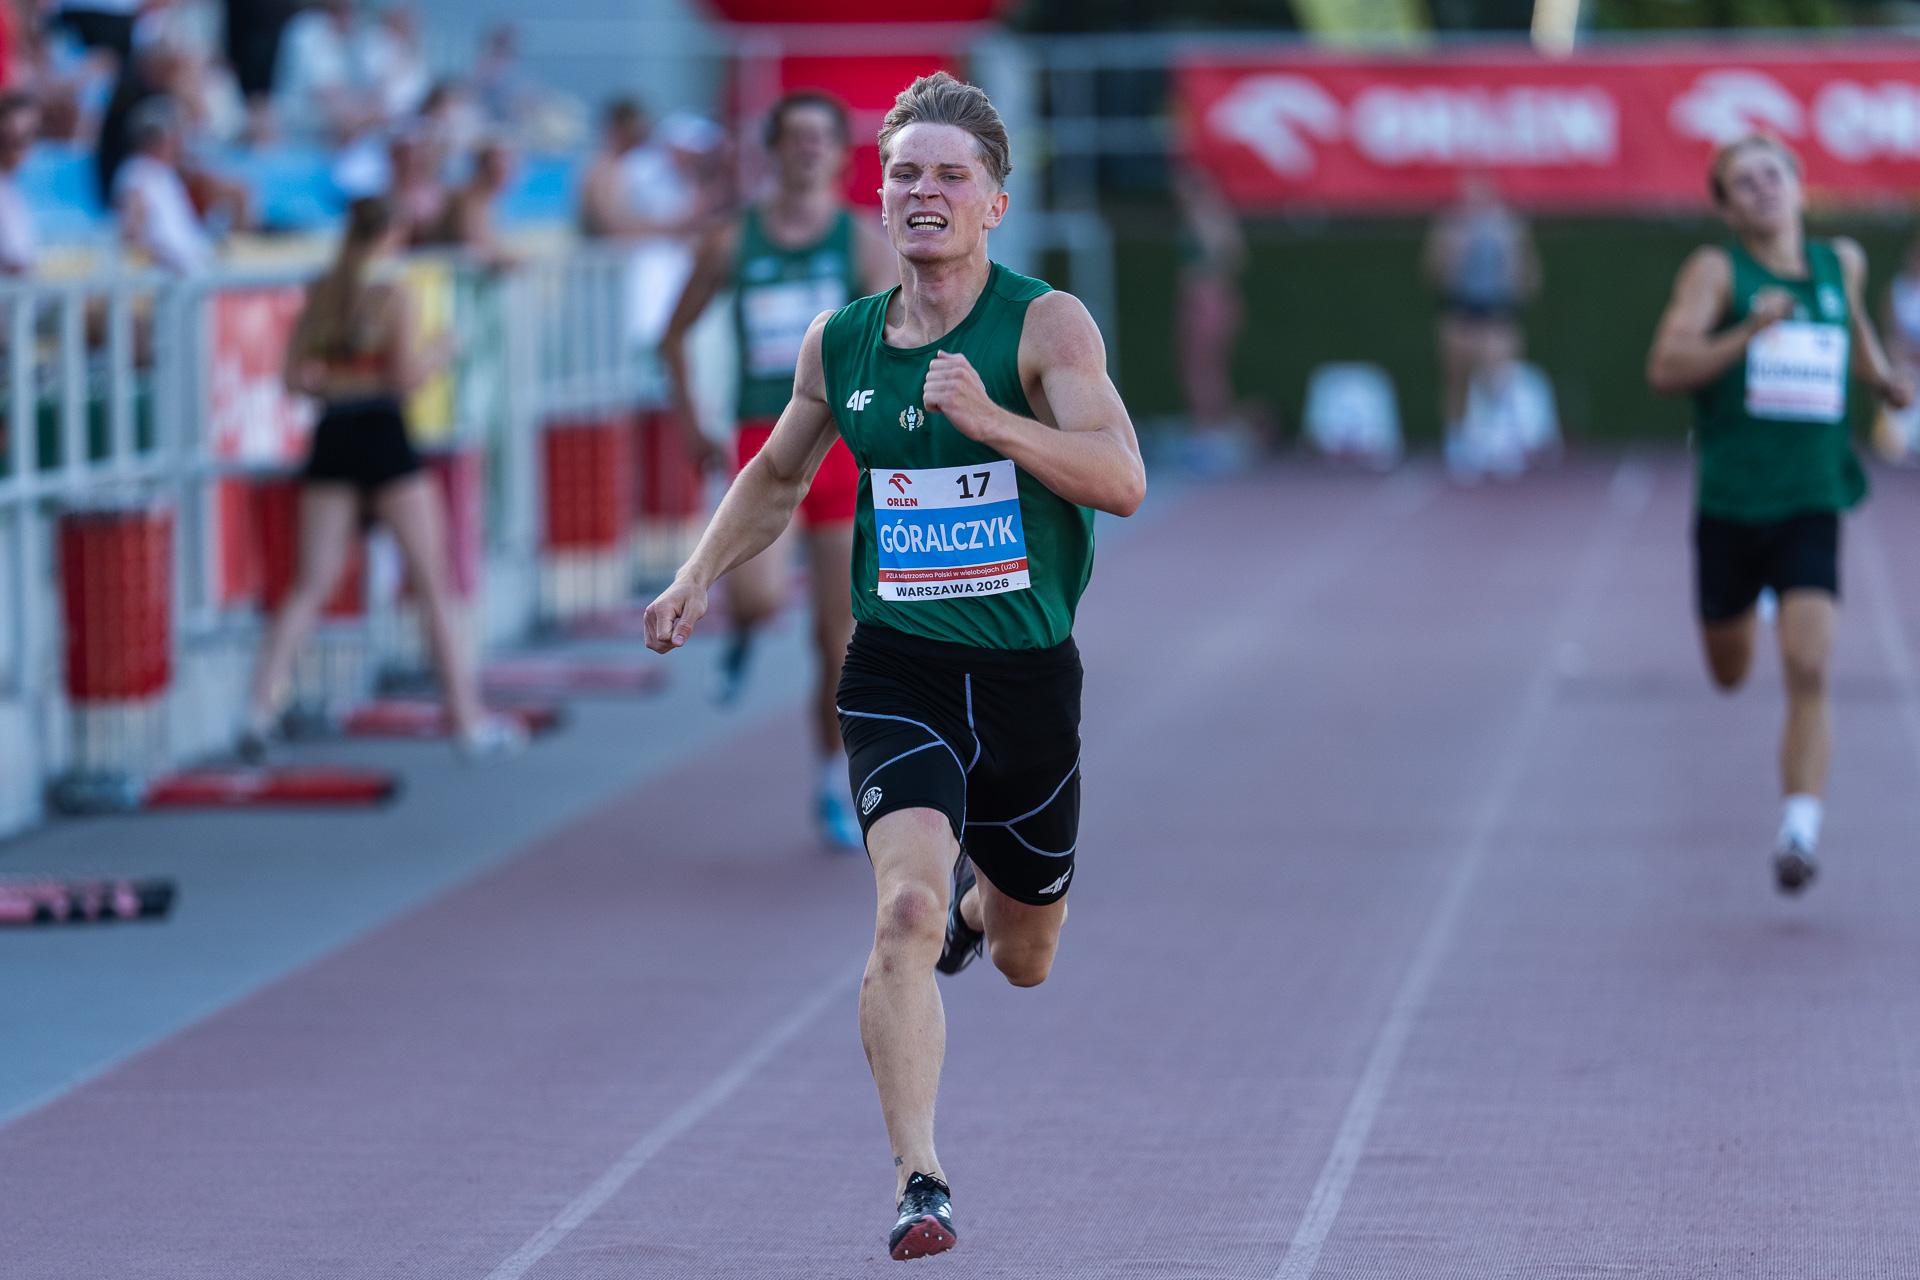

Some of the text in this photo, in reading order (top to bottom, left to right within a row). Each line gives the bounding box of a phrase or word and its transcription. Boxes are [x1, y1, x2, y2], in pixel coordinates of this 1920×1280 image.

[846, 389, 875, 411] 4F
[955, 471, 991, 500] 17
[886, 498, 918, 507] ORLEN
[880, 514, 1018, 554] GÓRALCZYK
[960, 566, 1000, 576] wielobojach
[1000, 561, 1019, 572] (U20)
[896, 578, 1010, 597] WARSZAWA 2026
